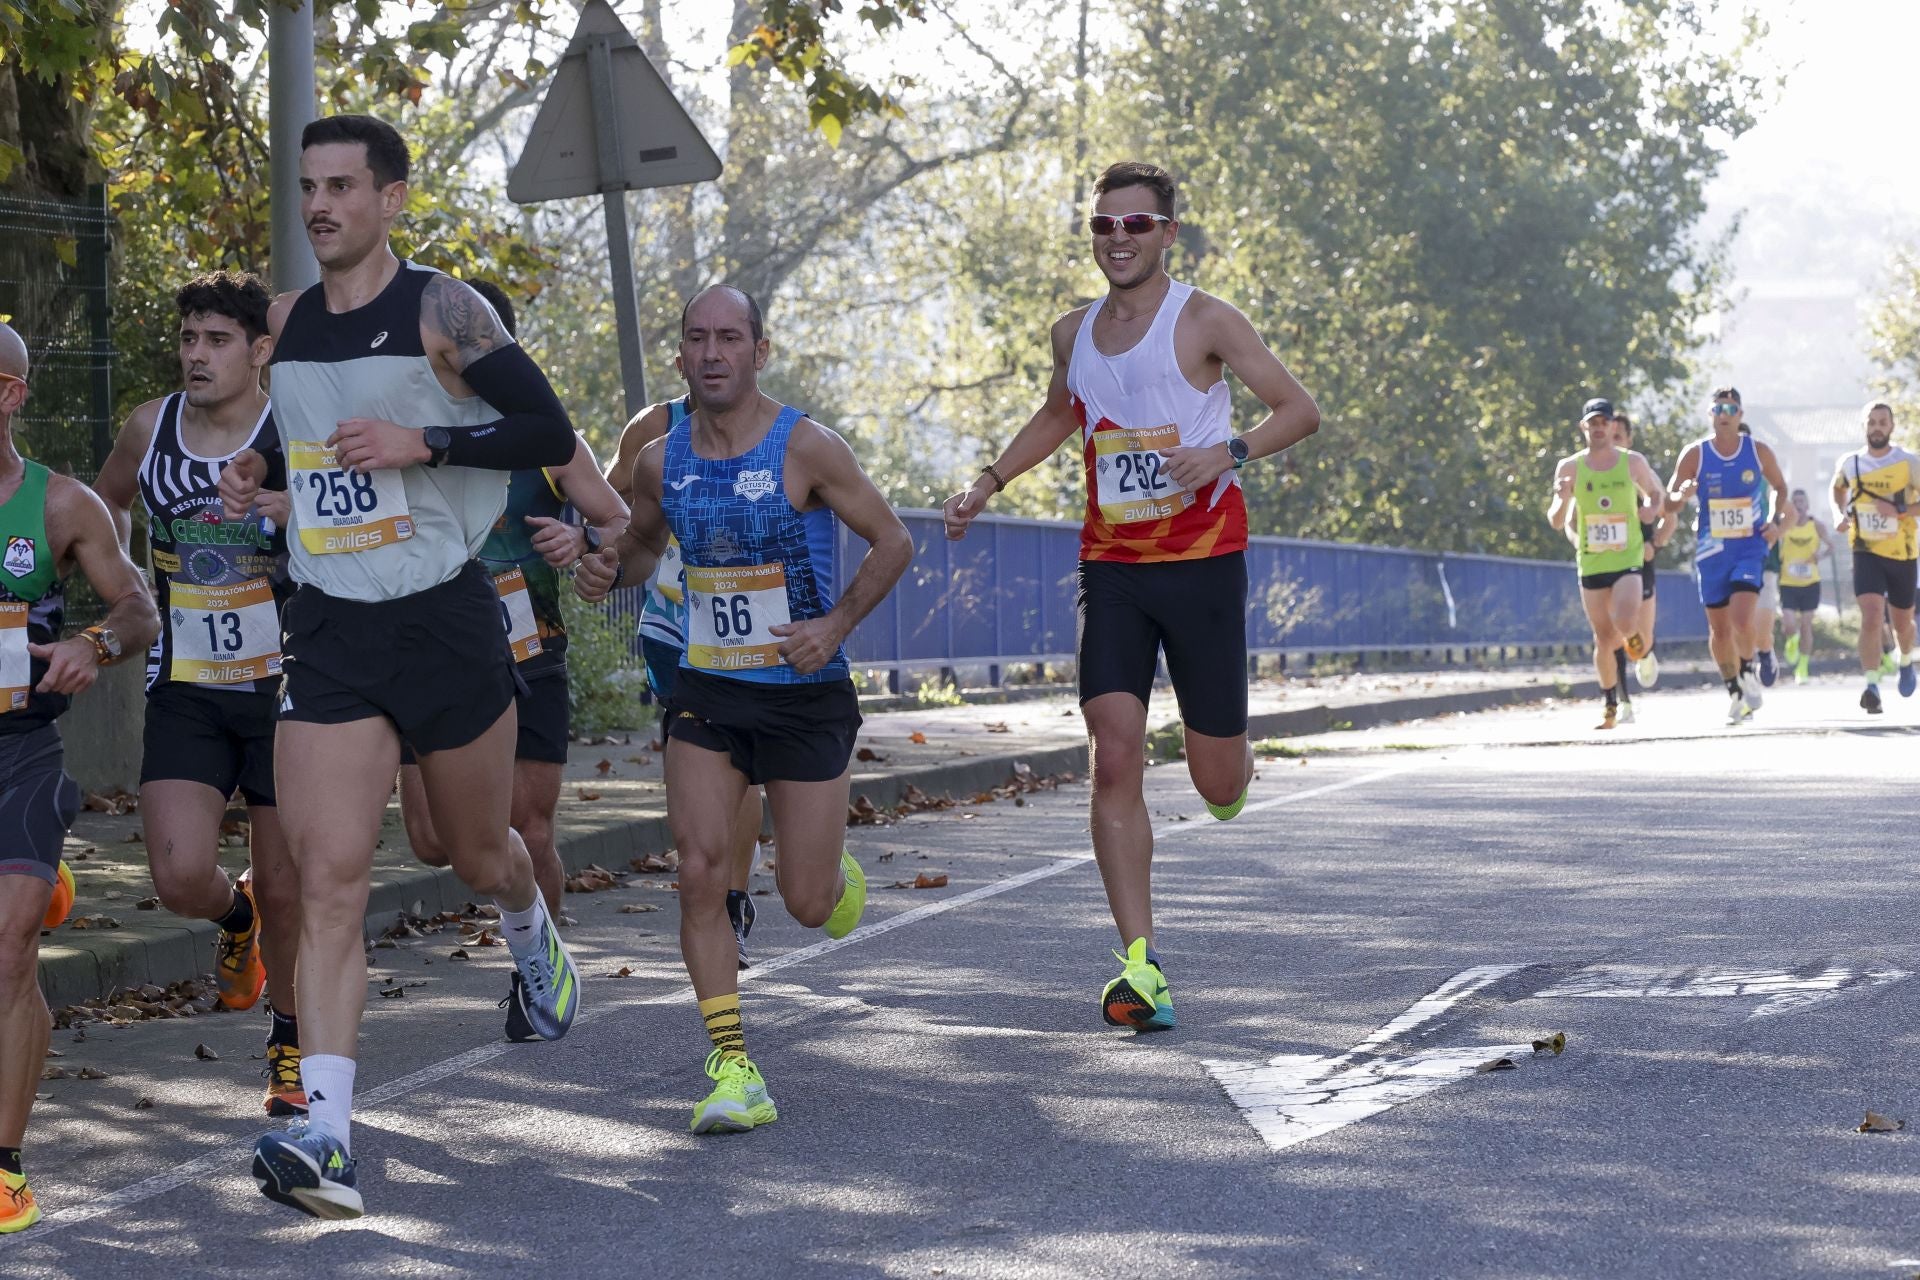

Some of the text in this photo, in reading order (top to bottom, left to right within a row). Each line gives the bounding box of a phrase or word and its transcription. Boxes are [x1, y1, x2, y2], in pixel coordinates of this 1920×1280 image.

[1152, 426, 1176, 437] AVILÉS
[321, 456, 337, 464] 202
[1116, 452, 1168, 493] 252
[309, 468, 378, 517] 258
[739, 482, 771, 490] VETUSTA
[1720, 510, 1744, 527] 135
[1866, 514, 1888, 530] 152
[171, 518, 272, 550] CEREZAL
[1594, 524, 1616, 540] 391
[326, 530, 382, 550] avilés
[498, 571, 521, 584] AVILÉS
[716, 569, 753, 578] MARATÓN
[754, 565, 780, 576] AVILÉS
[208, 586, 244, 596] MARATÓN
[714, 582, 738, 590] 2024
[711, 594, 752, 638] 66
[202, 612, 243, 652] 13
[722, 638, 744, 646] TONINO
[214, 652, 236, 661] JUANAN
[710, 652, 765, 666] avilés
[198, 666, 255, 680] avilés
